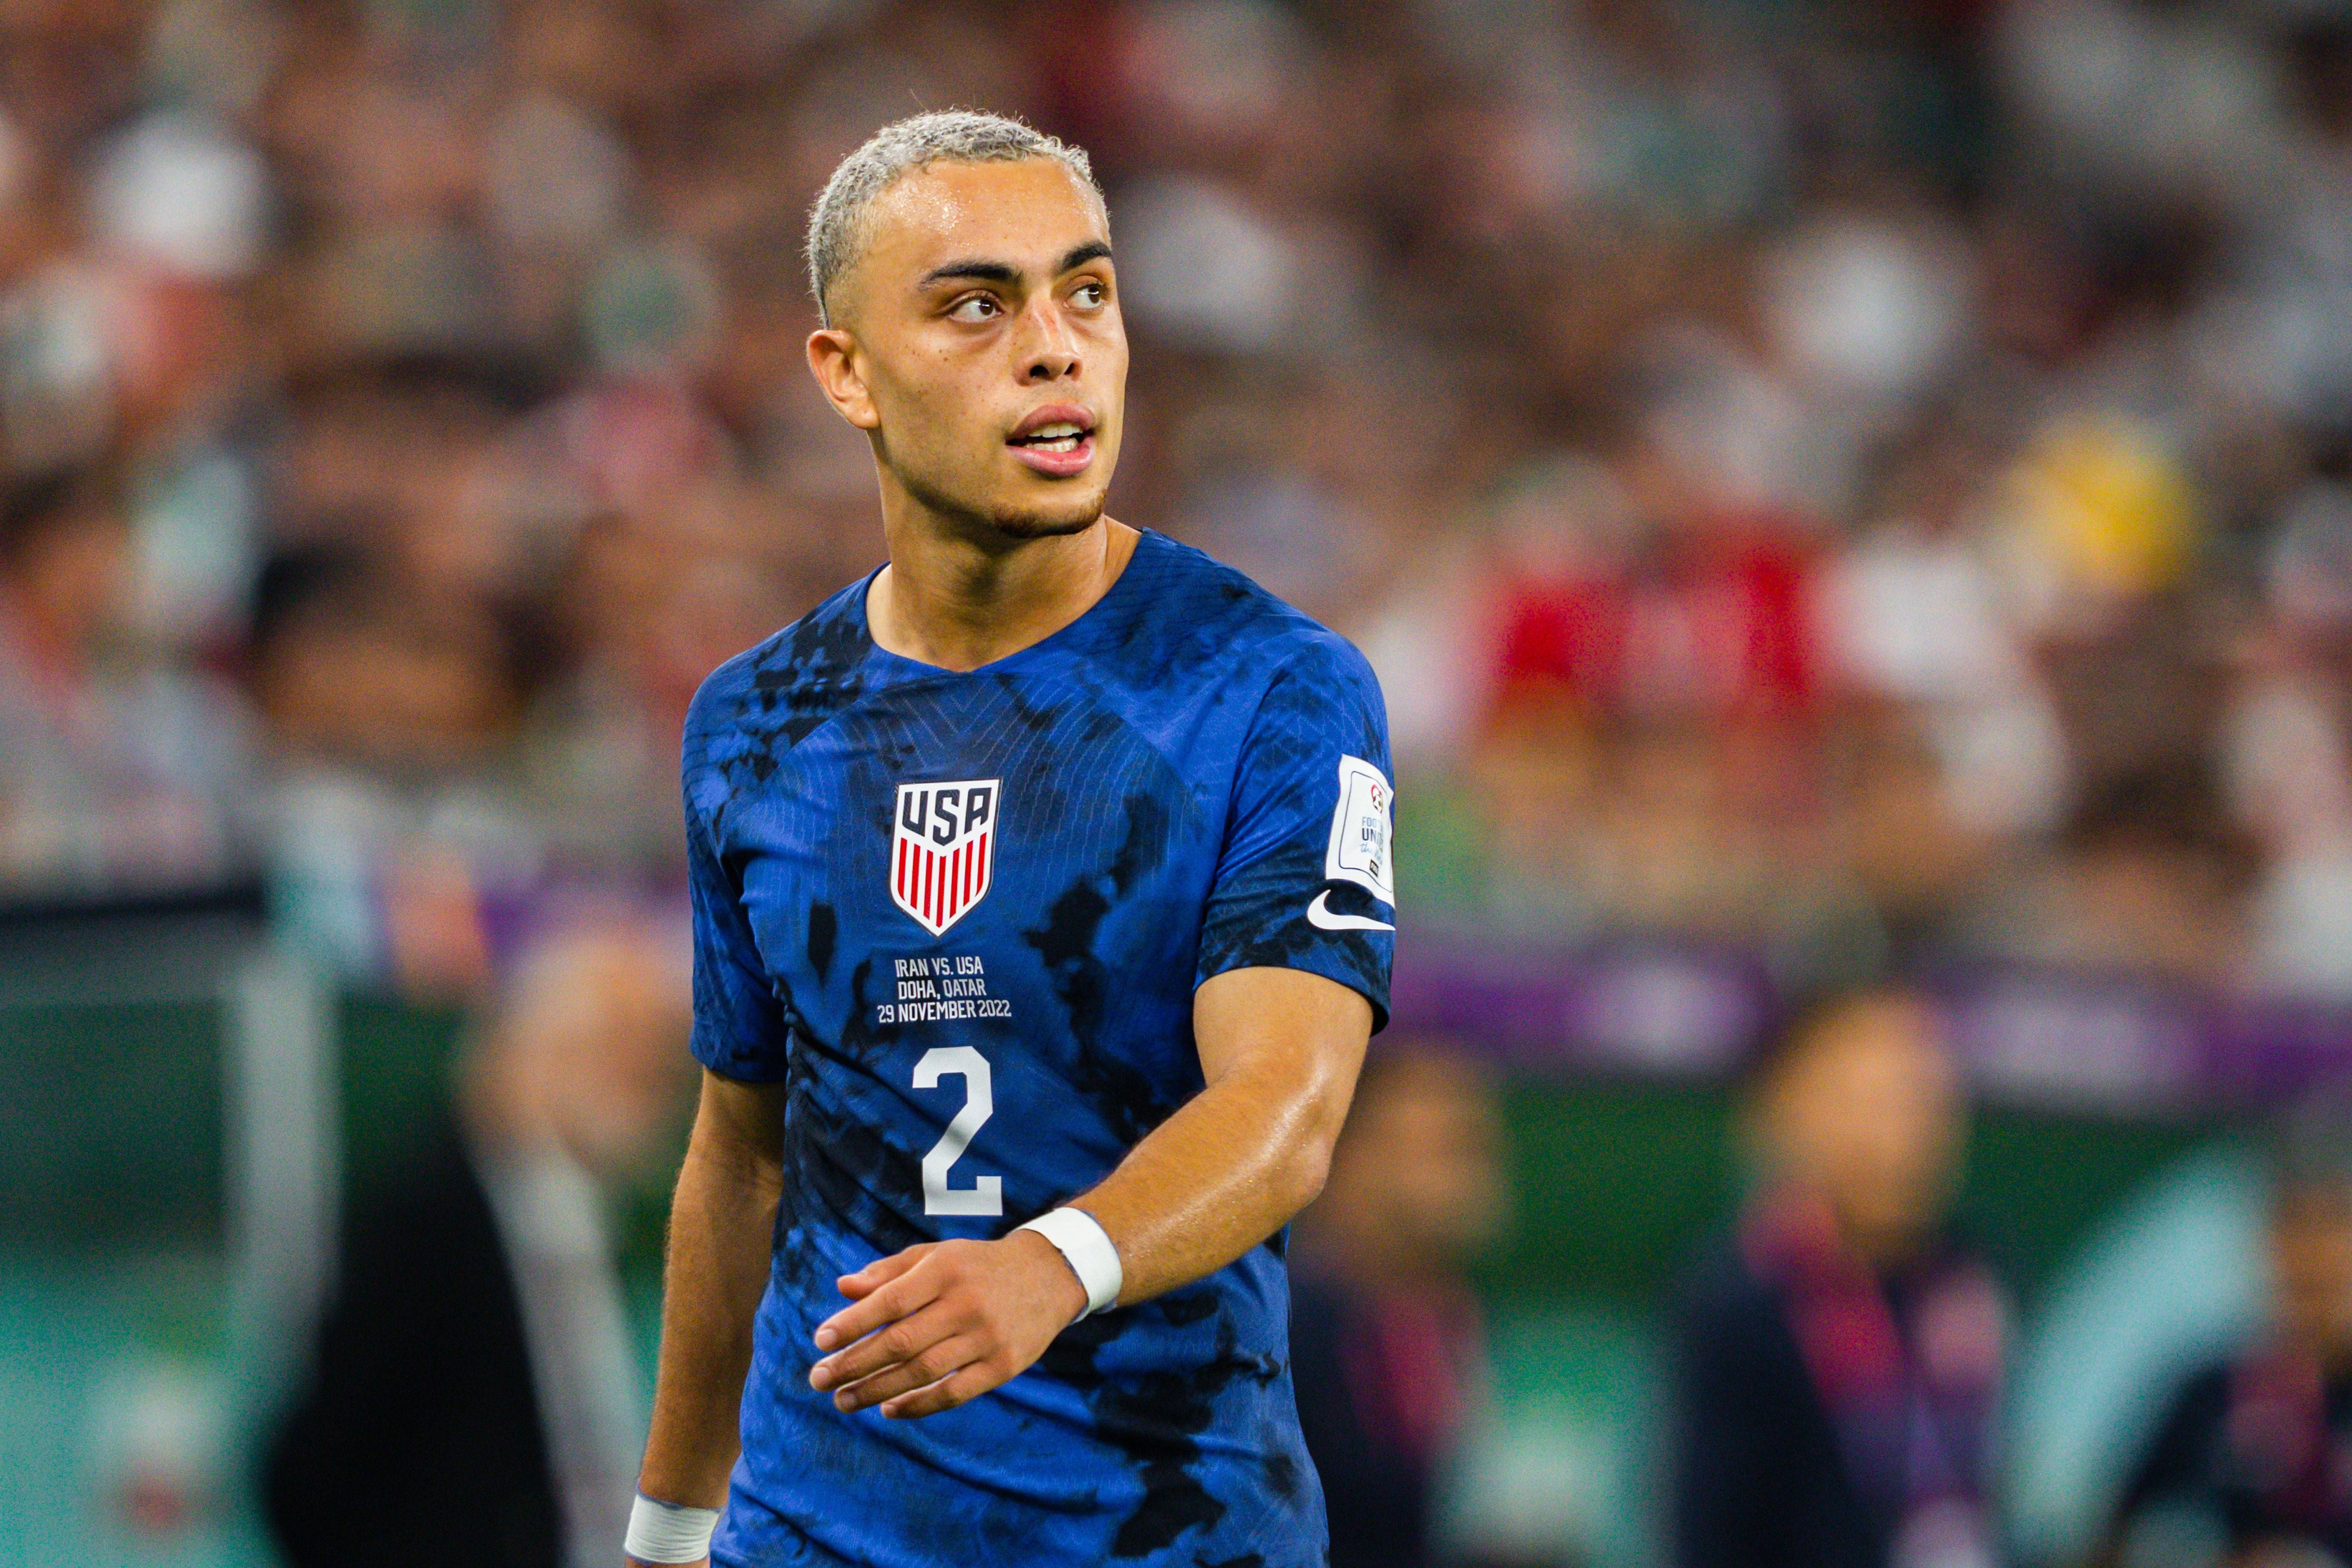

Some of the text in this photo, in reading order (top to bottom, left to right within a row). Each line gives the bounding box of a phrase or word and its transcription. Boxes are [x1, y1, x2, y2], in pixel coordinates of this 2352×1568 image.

[902, 787, 992, 846] USA
[895, 956, 984, 977] IRAN VS. USA
[898, 978, 987, 999] DOHA, QATAR
[877, 1000, 1012, 1023] 29 NOVEMBER 2022
[912, 1045, 1003, 1216] 2
